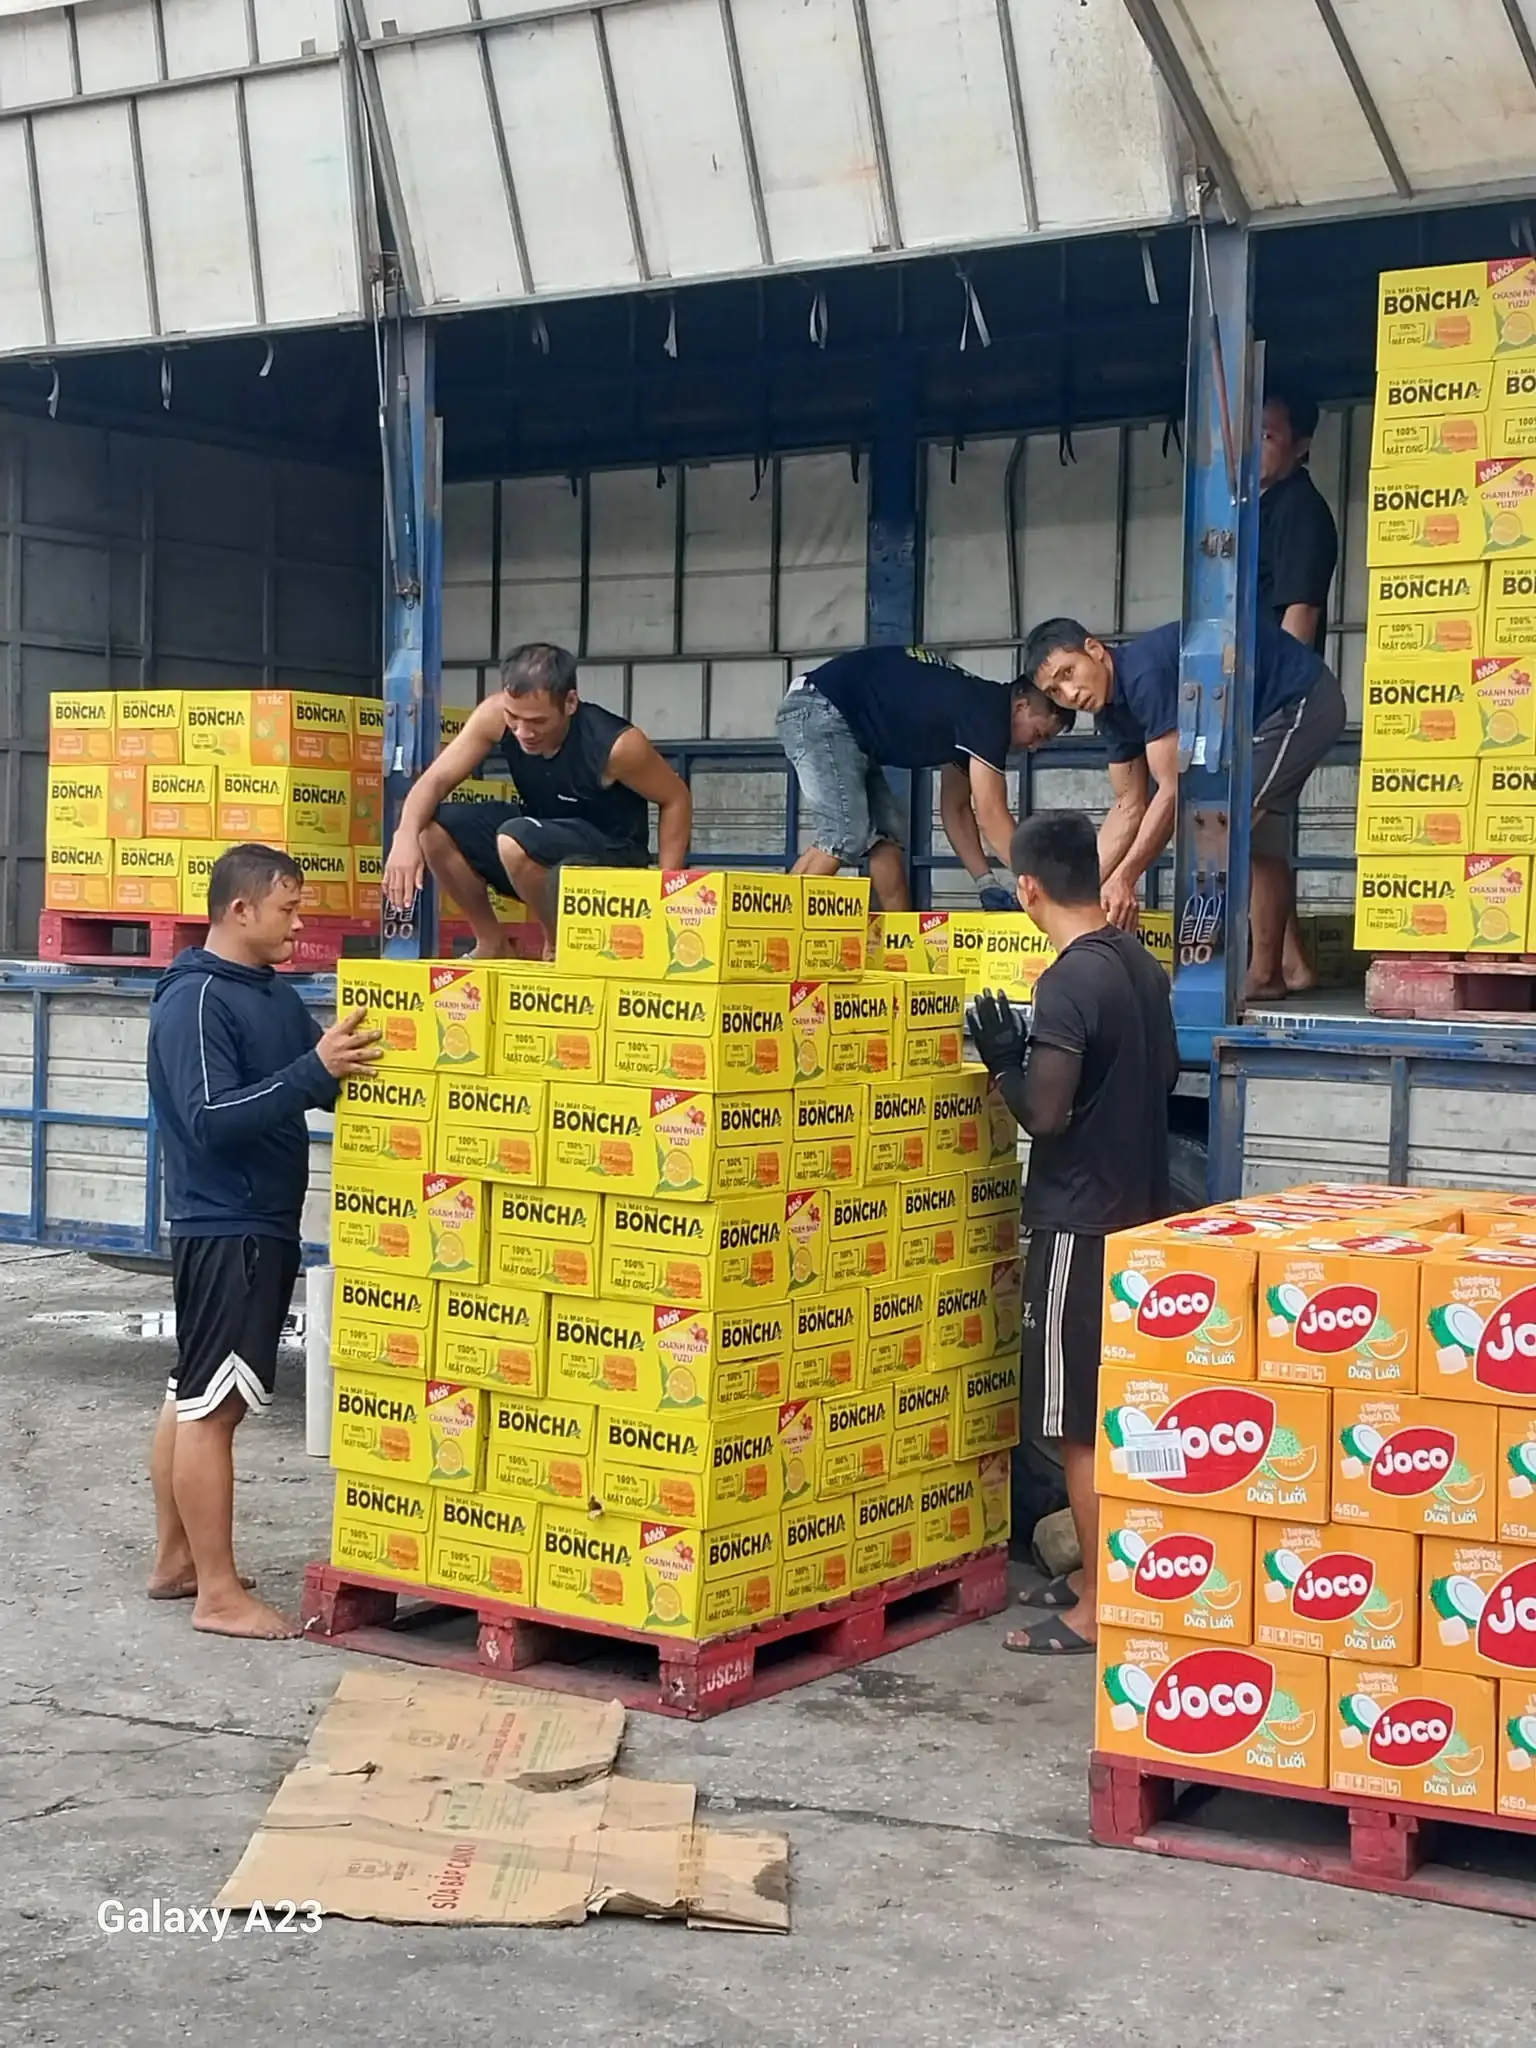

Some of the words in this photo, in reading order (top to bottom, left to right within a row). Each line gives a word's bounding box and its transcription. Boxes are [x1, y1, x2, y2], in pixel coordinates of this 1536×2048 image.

[1384, 289, 1479, 315] BONCHA
[1388, 381, 1481, 405] BONCHA
[1374, 488, 1468, 511] BONCHA
[1380, 578, 1470, 600] BONCHA
[1370, 685, 1464, 704] BONCHA
[56, 706, 106, 720] BONCHA
[123, 704, 176, 719] BONCHA
[189, 711, 245, 726] BONCHA
[297, 706, 346, 723] BONCHA
[360, 712, 383, 726] BON
[52, 785, 102, 799] BONCHA
[152, 779, 205, 793] BONCHA
[225, 779, 280, 794] BONCHA
[1372, 774, 1463, 792] BONCHA
[1492, 773, 1536, 790] BON
[293, 788, 346, 805] BONCHA
[52, 851, 103, 865] BONCHA
[122, 852, 174, 866] BONCHA
[188, 860, 214, 874] BON
[360, 860, 382, 873] BON
[1363, 880, 1455, 898] BONCHA
[563, 896, 651, 919] BONCHA
[732, 892, 792, 913] BONCHA
[808, 898, 862, 917] BONCHA
[953, 934, 983, 949] BON
[1137, 930, 1172, 949] NCHA
[342, 988, 424, 1011] BONCHA
[509, 992, 594, 1015] BONCHA
[618, 997, 706, 1022] BONCHA
[835, 998, 887, 1020] BONCHA
[911, 995, 960, 1016] BONCHA
[722, 1012, 783, 1033] BONCHA
[347, 1083, 426, 1107] BONCHA
[449, 1091, 531, 1115] BONCHA
[721, 1109, 782, 1130] BONCHA
[799, 1105, 854, 1126] BONCHA
[875, 1097, 926, 1120] BONCHA
[934, 1096, 982, 1119] BONCHA
[553, 1110, 642, 1136] BONCHA
[906, 1189, 956, 1213] BONCHA
[971, 1179, 1017, 1202] BONCHA
[336, 1192, 418, 1219] BONCHA
[503, 1200, 587, 1228] BONCHA
[834, 1200, 887, 1226] BONCHA
[615, 1211, 704, 1238] BONCHA
[721, 1220, 780, 1248] BONCHA
[343, 1286, 422, 1313] BONCHA
[873, 1294, 923, 1322] BONCHA
[938, 1290, 987, 1316] BONCHA
[1142, 1291, 1209, 1319] joco
[448, 1299, 529, 1327] BONCHA
[798, 1306, 853, 1333] BONCHA
[1301, 1304, 1371, 1334] joco
[557, 1322, 645, 1351] BONCHA
[721, 1325, 781, 1348] BONCHA
[1486, 1312, 1536, 1361] jo
[968, 1369, 1016, 1399] BONCHA
[339, 1394, 418, 1424] BONCHA
[899, 1385, 950, 1414] BONCHA
[498, 1410, 581, 1439] BONCHA
[830, 1402, 886, 1432] BONCHA
[609, 1425, 699, 1455] BONCHA
[714, 1435, 773, 1468] BONCHA
[1376, 1445, 1448, 1475] joco
[347, 1488, 424, 1519] BONCHA
[921, 1480, 973, 1512] BONCHA
[444, 1504, 526, 1536] BONCHA
[859, 1494, 914, 1525] BONCHA
[788, 1513, 846, 1543] BONCHA
[545, 1532, 631, 1566] BONCHA
[709, 1531, 772, 1565] BONCHA
[1141, 1551, 1208, 1580] joco
[1298, 1571, 1367, 1601] joco
[1488, 1586, 1536, 1634] jo
[1155, 1675, 1262, 1720] joco
[1375, 1716, 1447, 1746] joco
